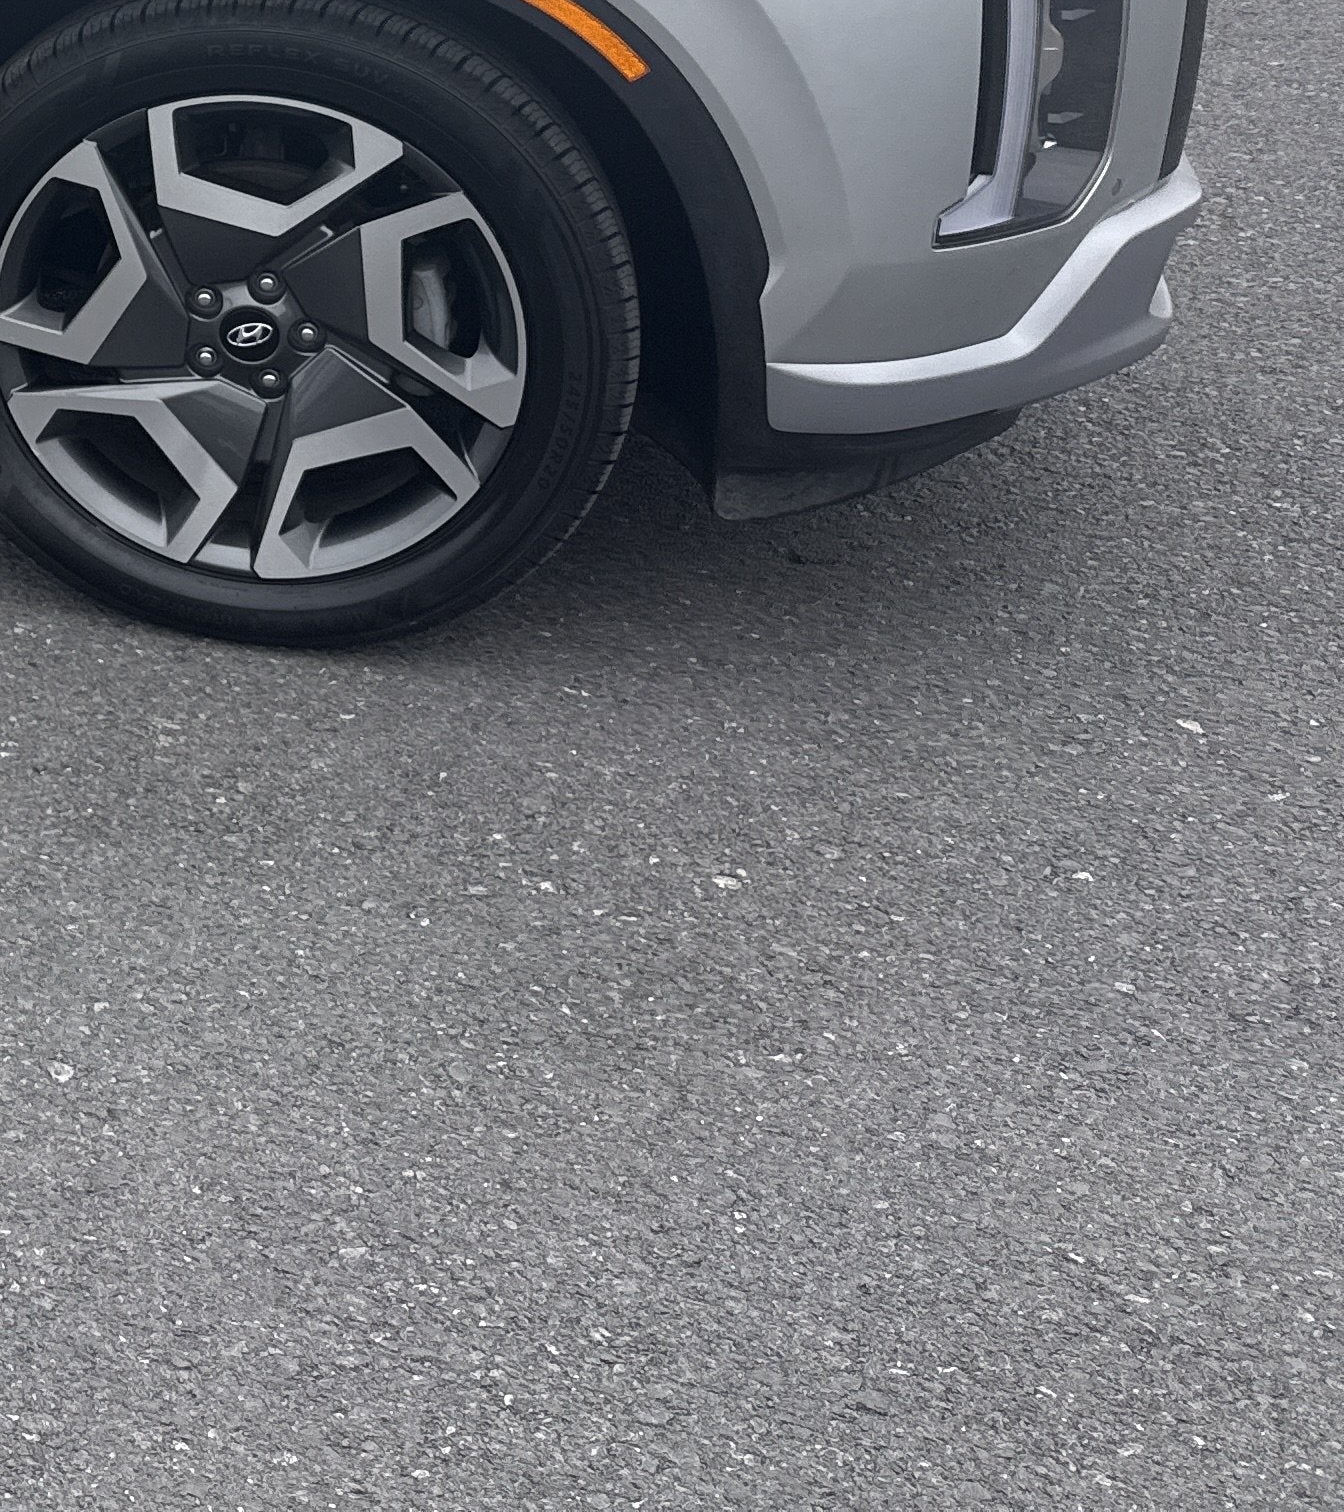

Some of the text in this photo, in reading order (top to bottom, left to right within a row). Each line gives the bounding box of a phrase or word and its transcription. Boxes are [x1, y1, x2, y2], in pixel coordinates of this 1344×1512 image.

[207, 43, 390, 83] REFLEX SUV
[537, 371, 582, 489] 245/50R20
